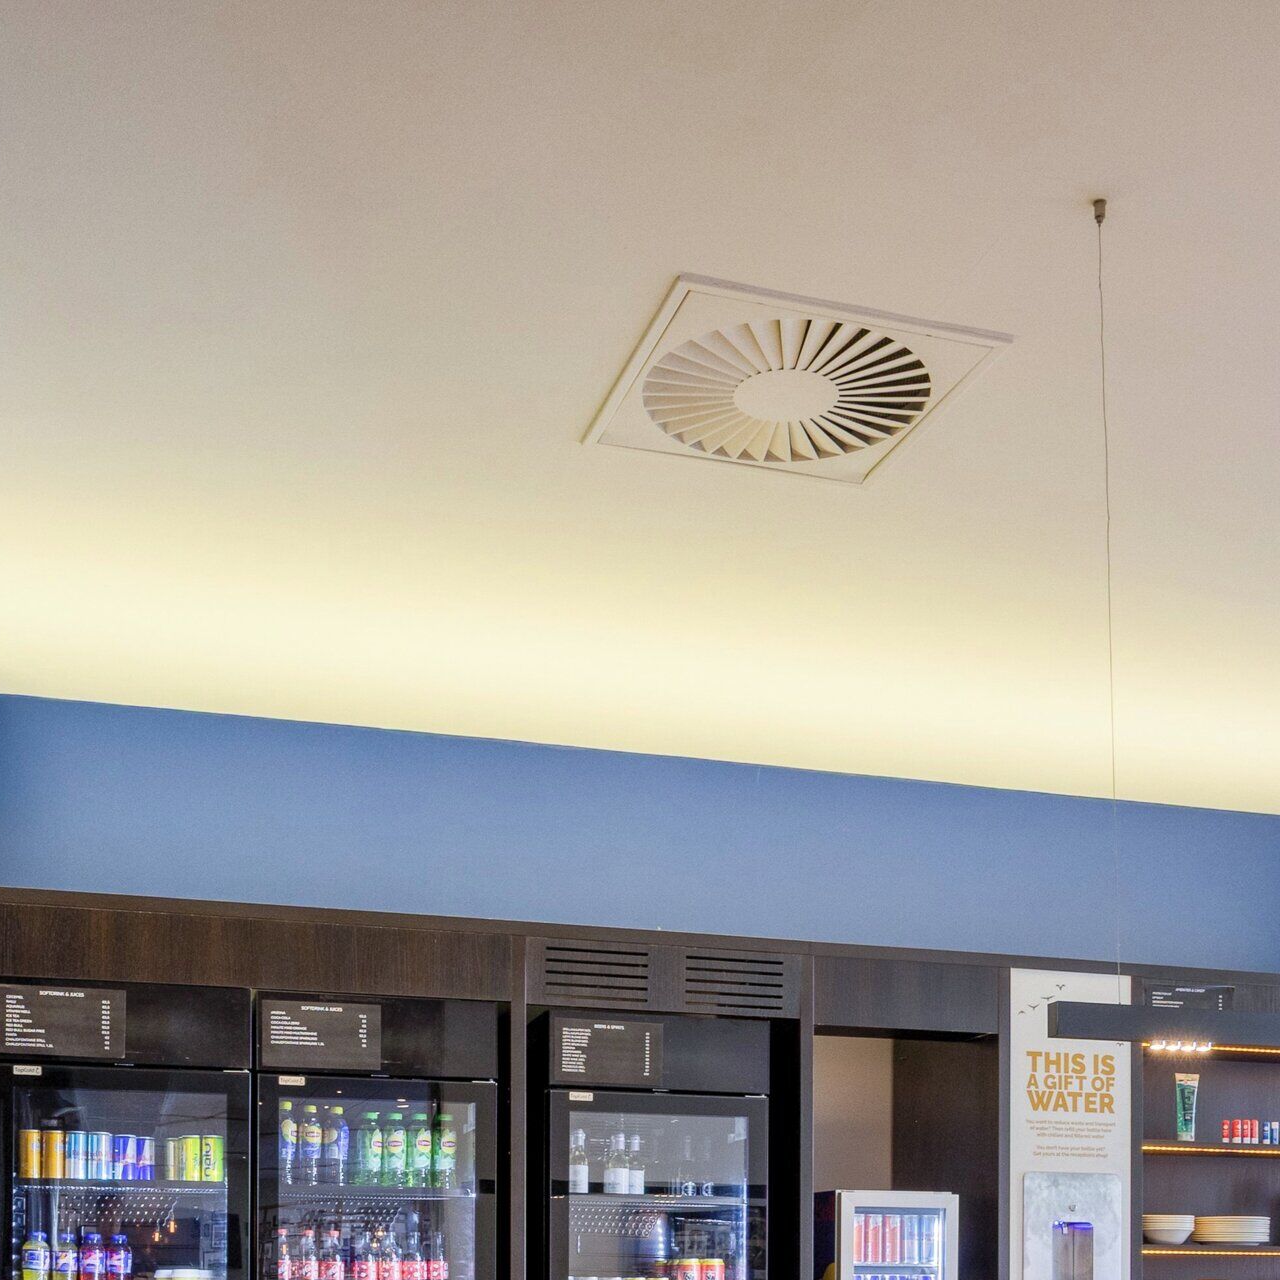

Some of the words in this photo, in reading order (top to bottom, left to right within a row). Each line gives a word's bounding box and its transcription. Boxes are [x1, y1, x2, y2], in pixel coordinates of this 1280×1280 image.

[1026, 1051, 1086, 1075] THIS
[1093, 1054, 1116, 1076] IS
[1026, 1073, 1039, 1089] A
[1043, 1074, 1087, 1091] GIFT
[1091, 1076, 1116, 1092] OF
[1026, 1090, 1115, 1114] WATER
